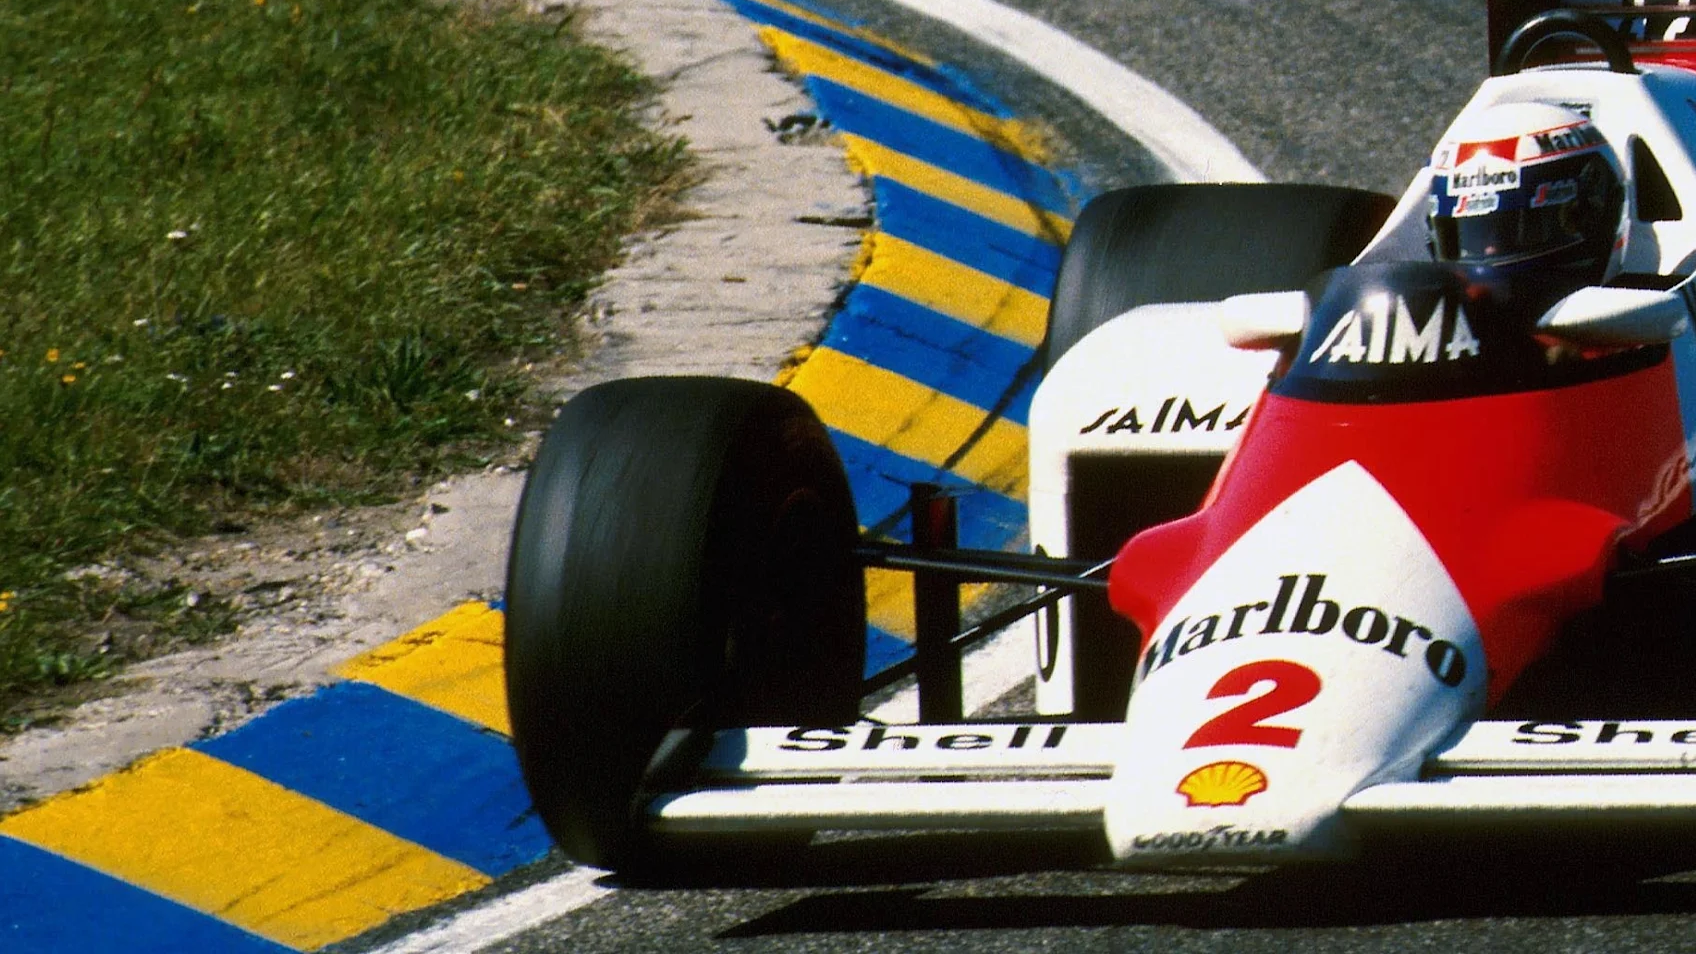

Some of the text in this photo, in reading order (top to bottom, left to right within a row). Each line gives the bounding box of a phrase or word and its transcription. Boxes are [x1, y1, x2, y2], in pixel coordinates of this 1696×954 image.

[1453, 166, 1518, 189] Marlboro
[1308, 296, 1480, 364] SAIMA
[1144, 574, 1467, 689] Marlboro
[1182, 659, 1323, 750] 2
[778, 725, 1067, 754] Shell
